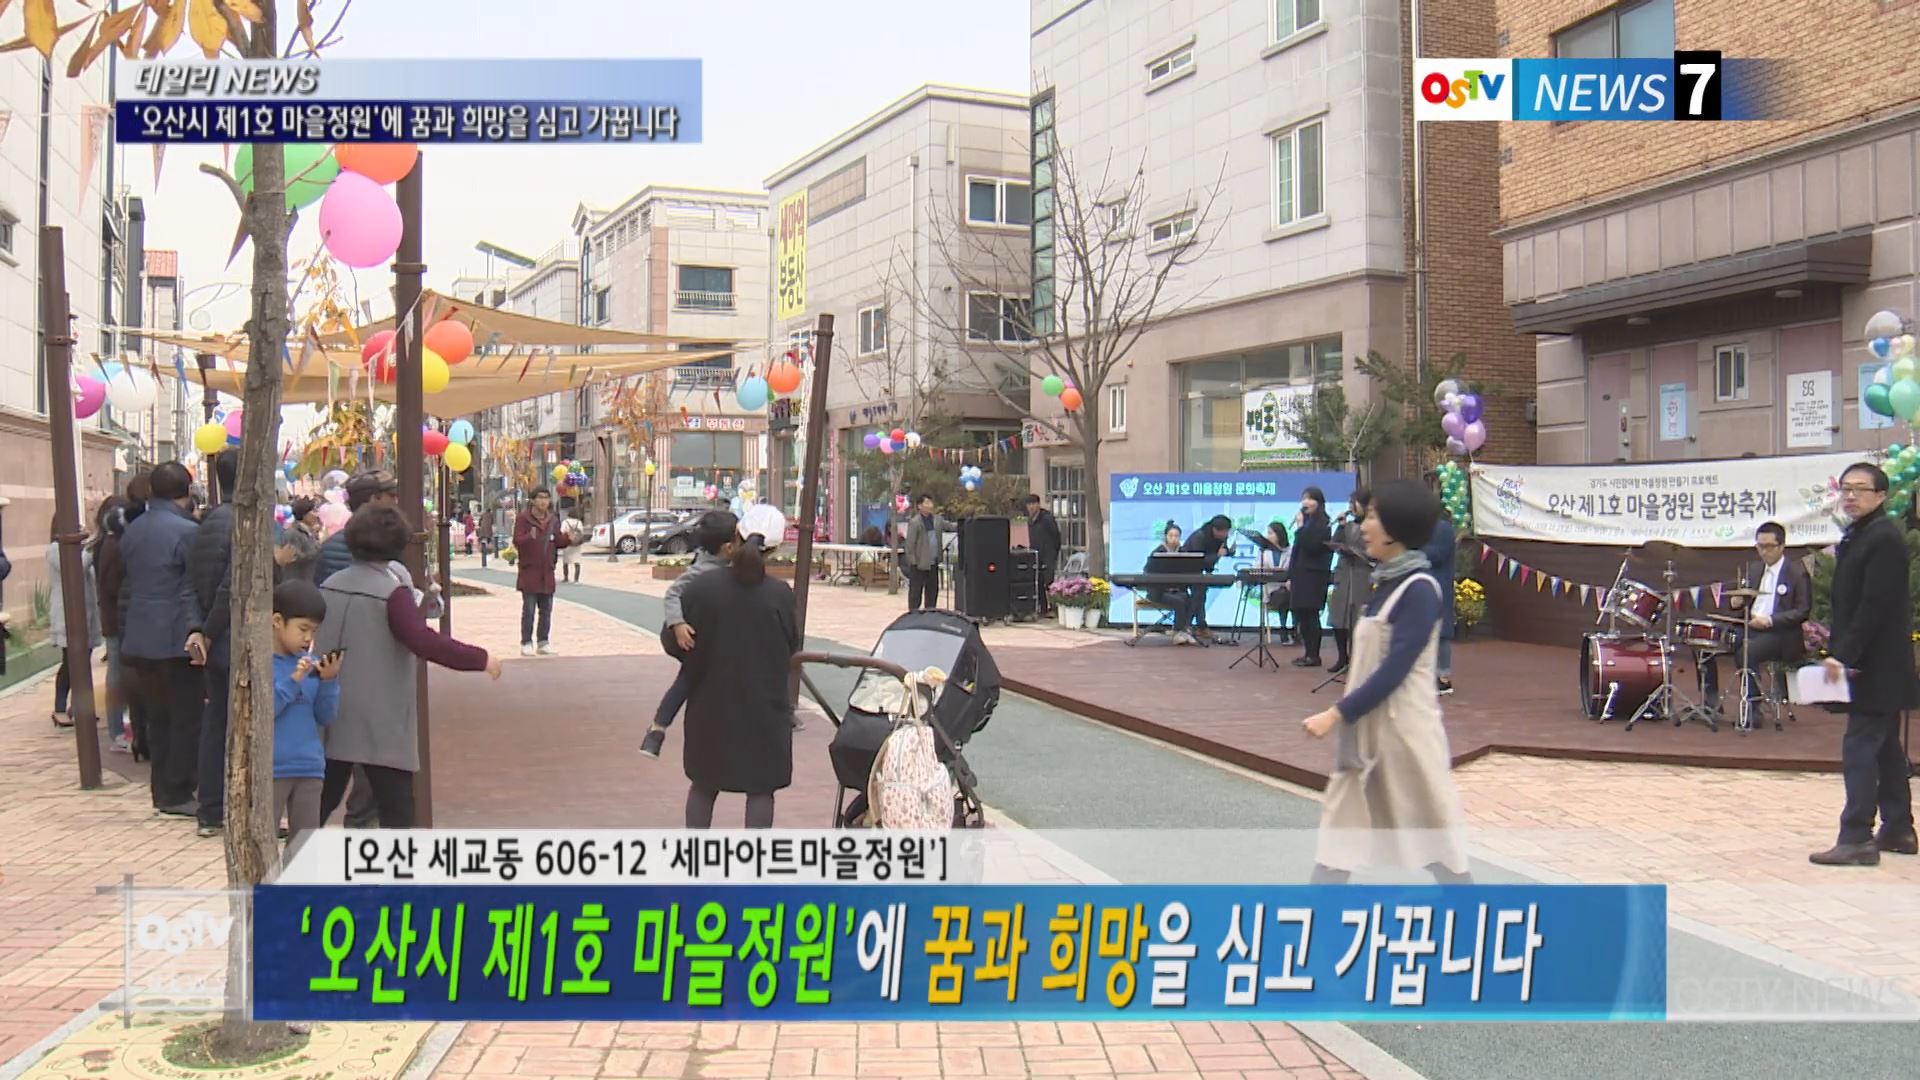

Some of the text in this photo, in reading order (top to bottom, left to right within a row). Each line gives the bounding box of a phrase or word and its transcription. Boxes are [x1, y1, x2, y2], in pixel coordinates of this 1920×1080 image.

[780, 195, 805, 254] 세마역
[780, 251, 804, 312] 부동산
[1143, 482, 1162, 496] 오산
[1165, 482, 1190, 496] 제1호
[1546, 493, 1576, 519] 오산
[1627, 492, 1694, 521] 마을정원
[1701, 489, 1776, 520] 문화축제
